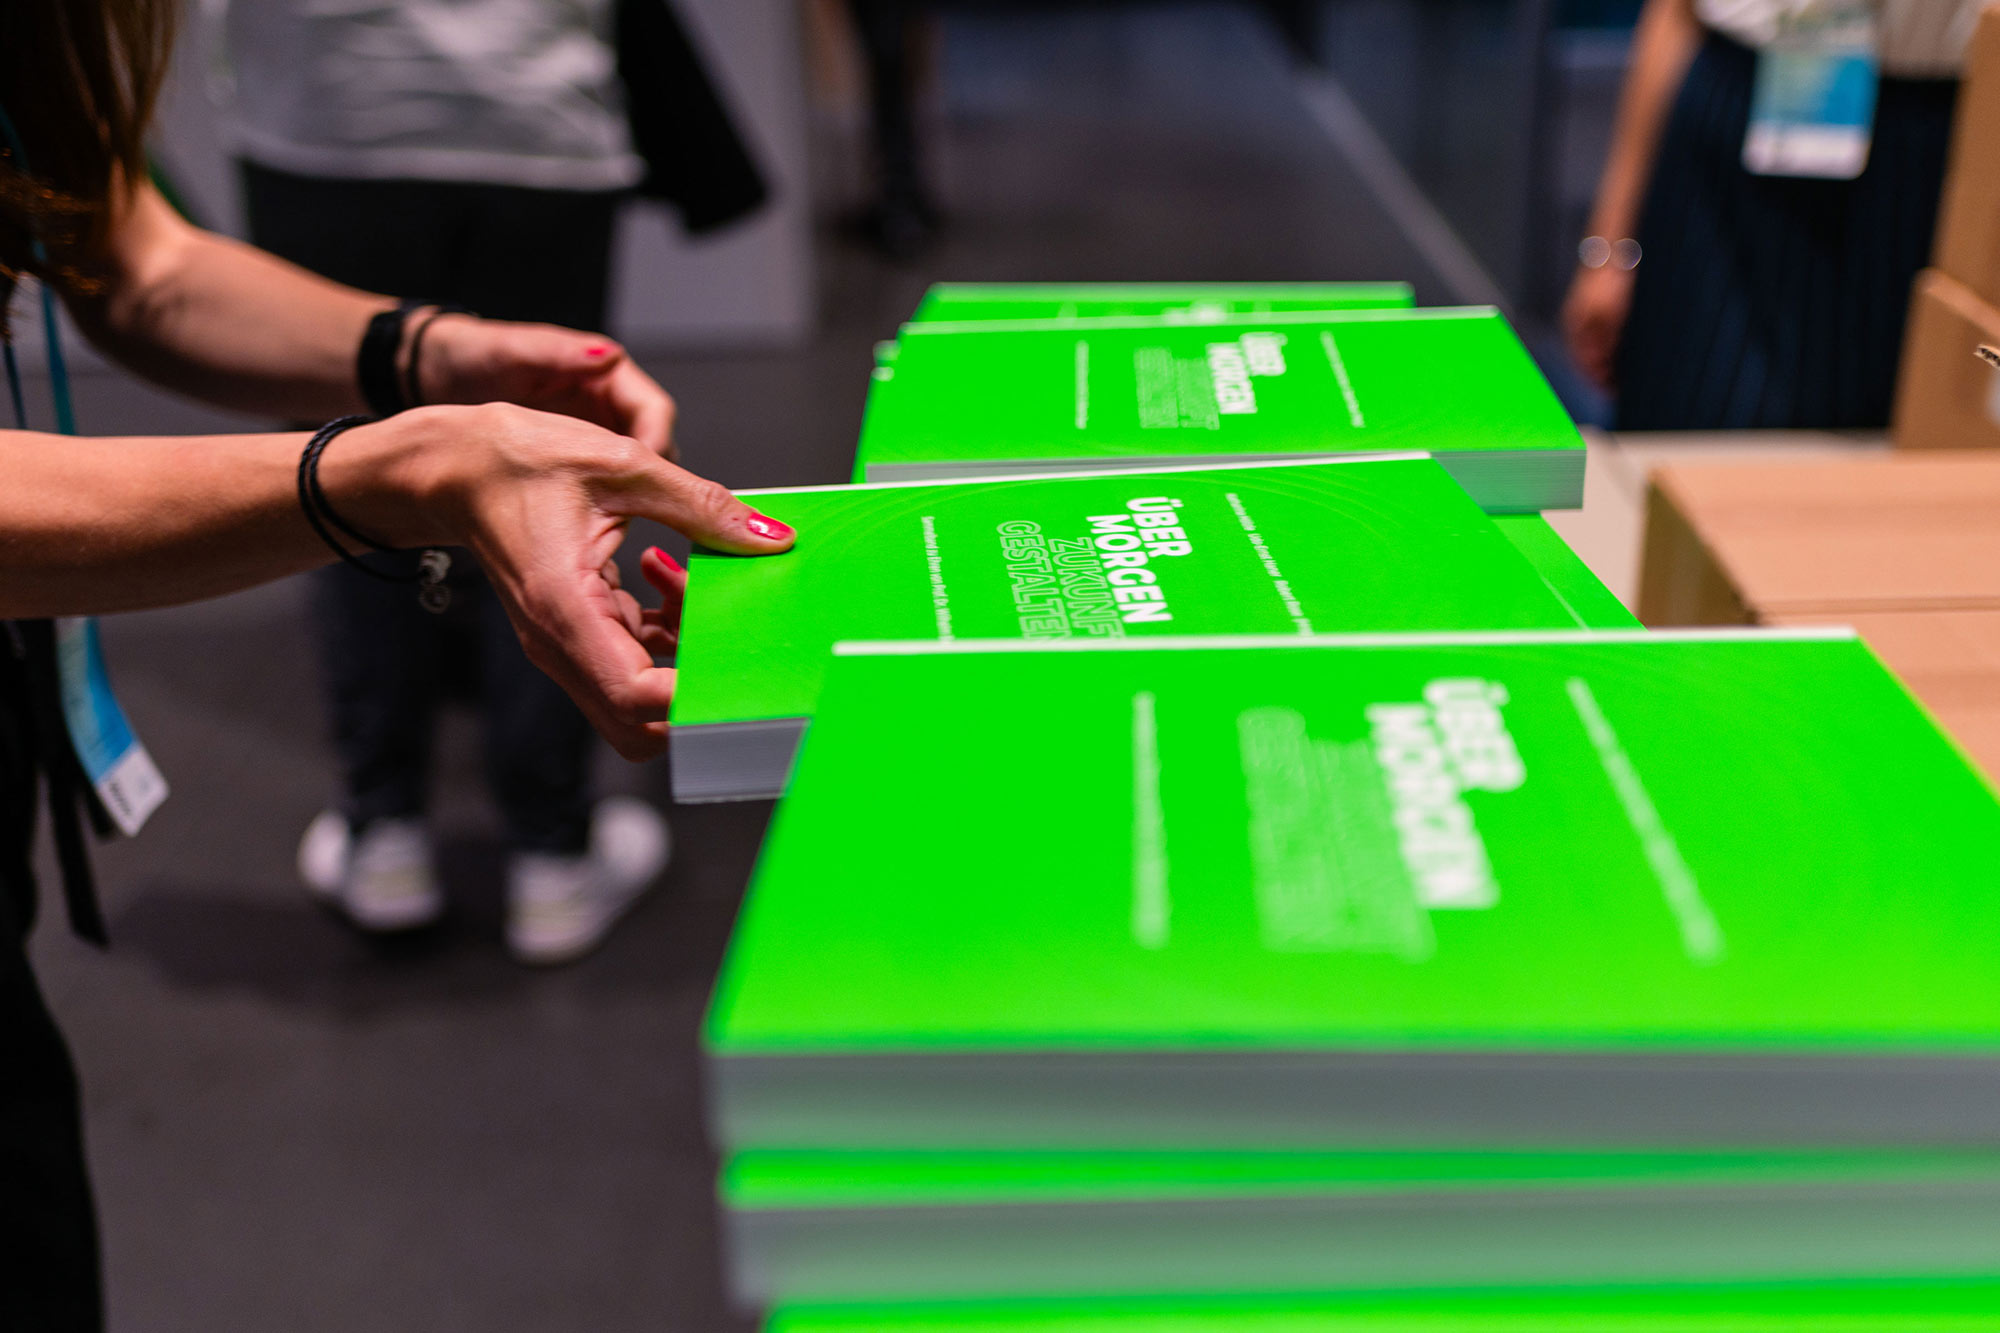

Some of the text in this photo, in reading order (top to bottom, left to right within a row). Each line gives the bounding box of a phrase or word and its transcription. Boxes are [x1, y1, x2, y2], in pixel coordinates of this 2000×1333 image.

[1085, 513, 1174, 623] MORGEN
[1125, 497, 1194, 558] ÜBER
[1047, 536, 1126, 640] ZUKUNF
